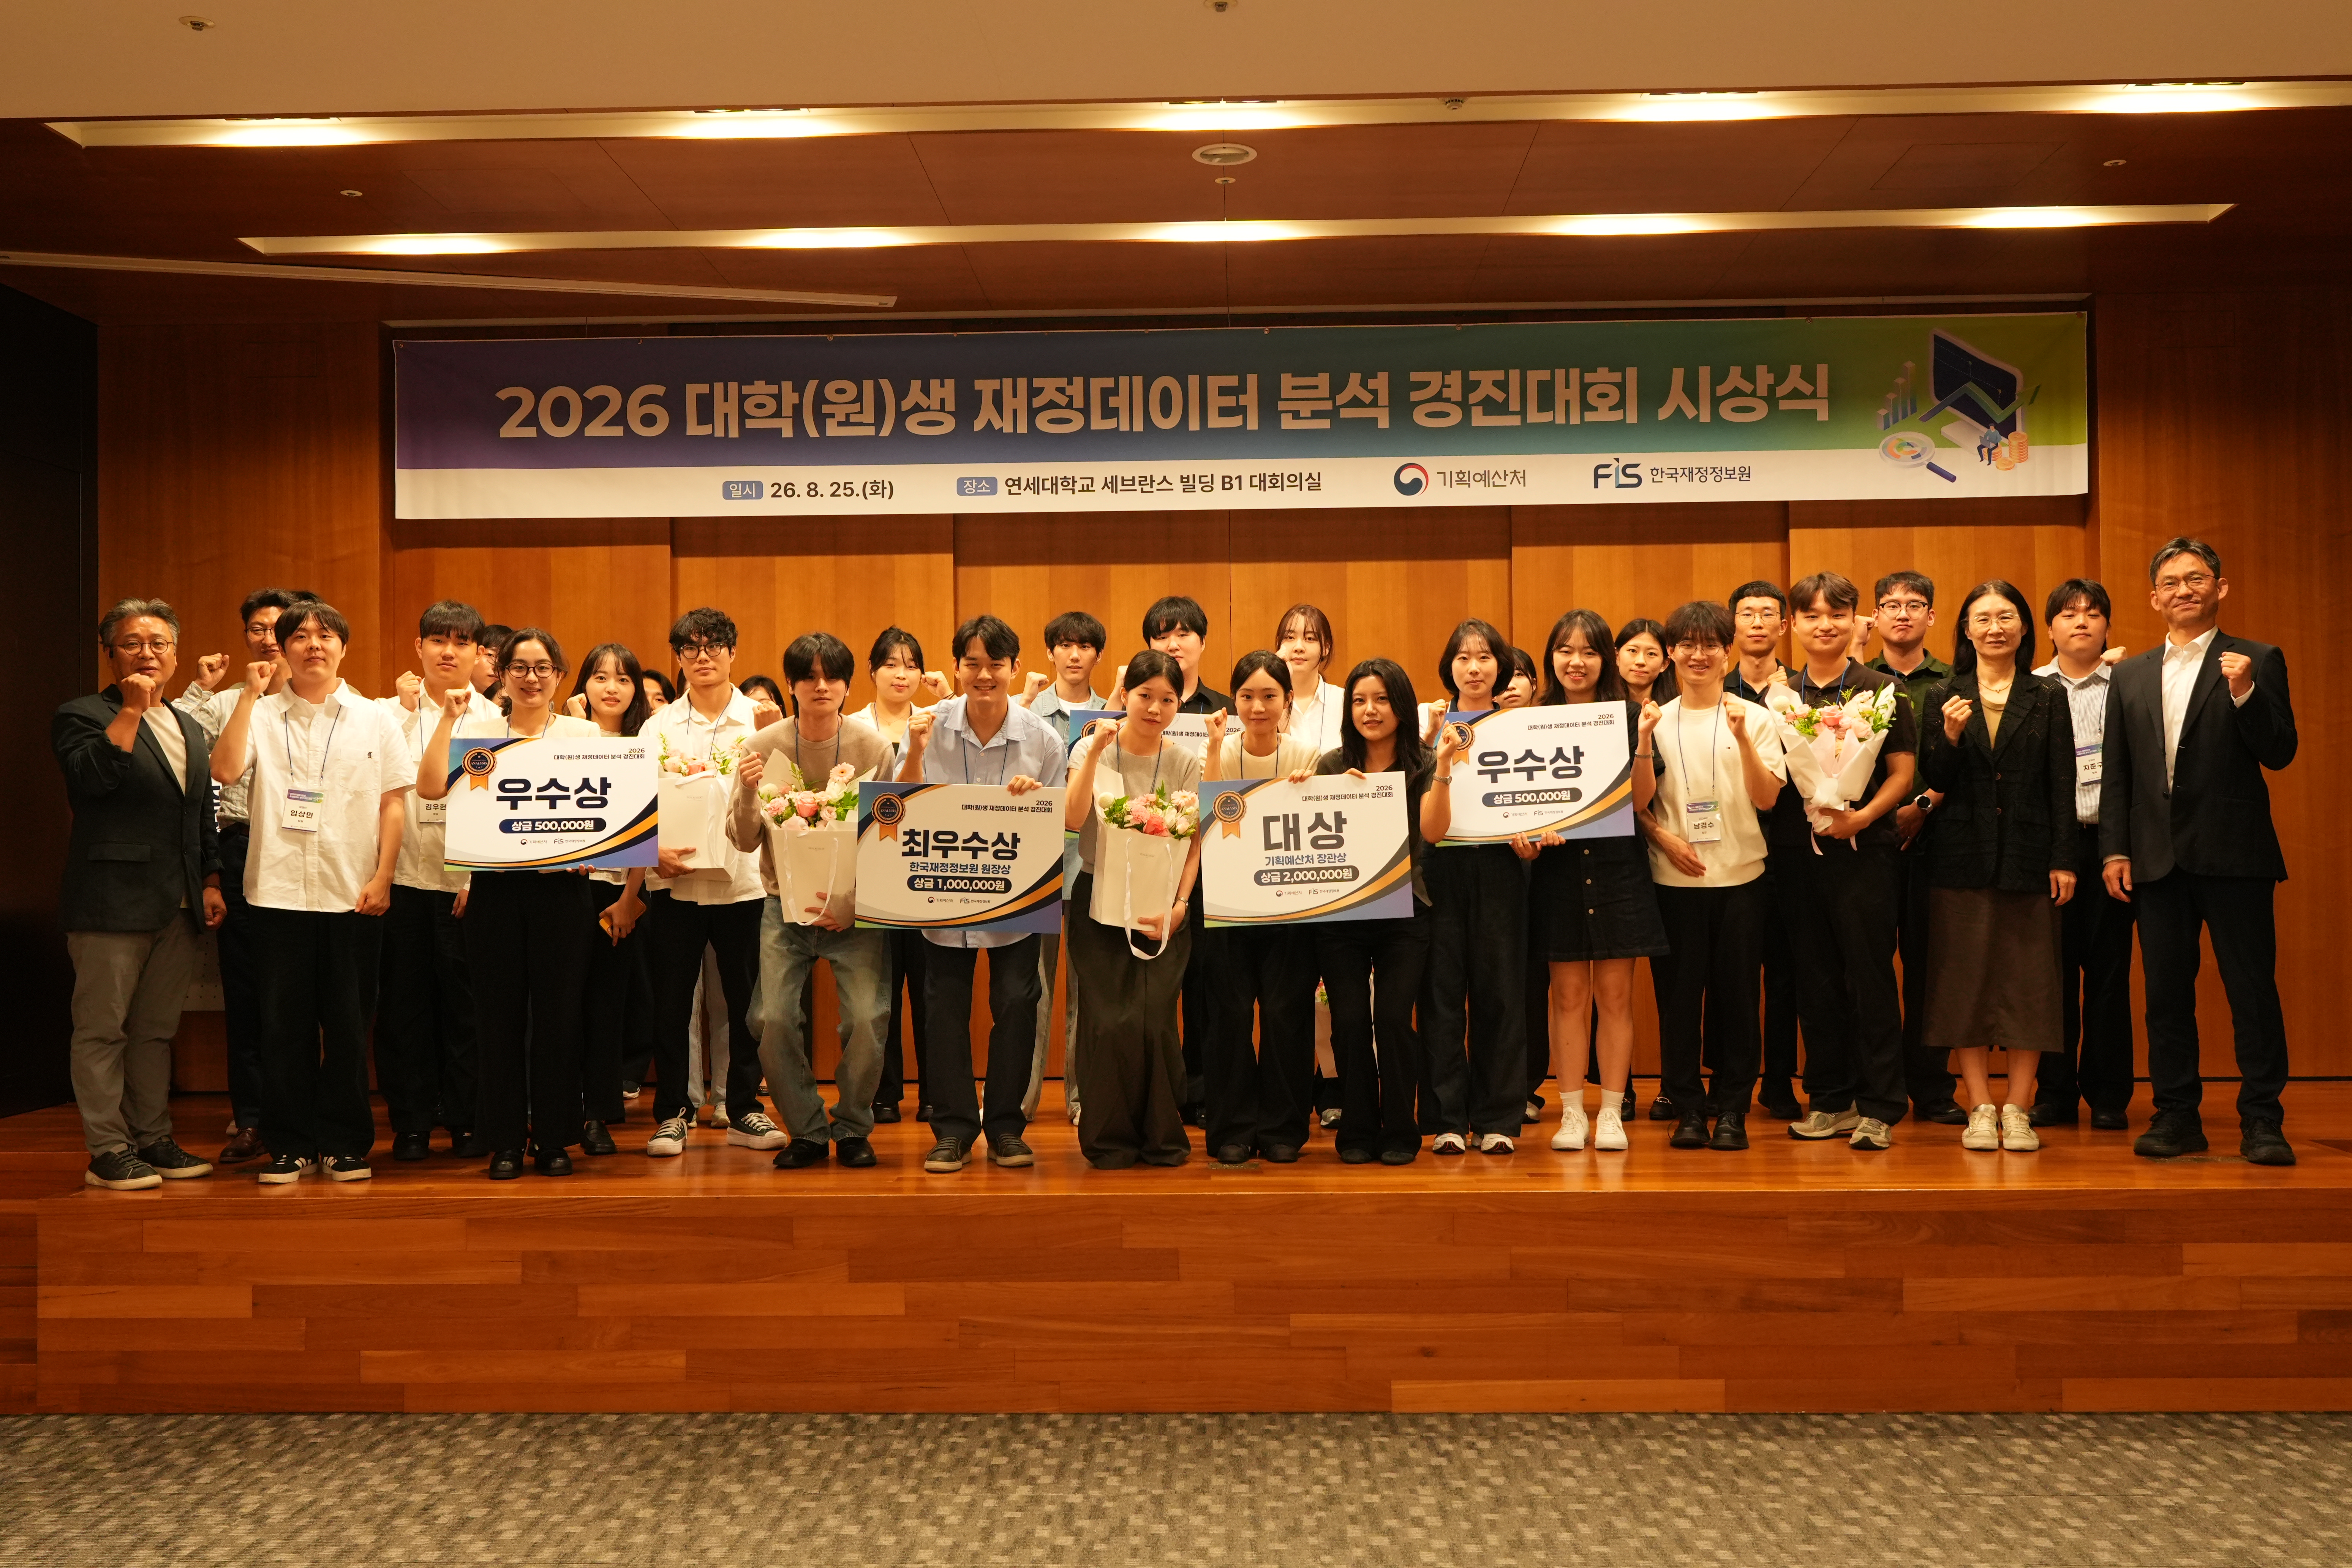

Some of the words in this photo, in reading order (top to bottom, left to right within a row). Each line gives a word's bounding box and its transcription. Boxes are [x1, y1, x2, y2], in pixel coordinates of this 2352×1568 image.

[495, 384, 669, 438] 2026
[686, 379, 955, 438] 대학(원)생
[974, 374, 1258, 433] 재정데이터
[1278, 372, 1389, 429] 분석
[1410, 367, 1638, 427] 경진대회
[1658, 364, 1829, 422] 시상식
[1437, 469, 1525, 488] 기획예산처
[1650, 466, 1750, 482] 한국재정정보원
[730, 483, 755, 497] 일시
[771, 482, 800, 498] 26.
[807, 482, 824, 497] 8.
[830, 480, 893, 499] 25.(화)
[964, 479, 990, 493] 장소
[1005, 476, 1095, 495] 연세대학교
[1101, 475, 1173, 494] 세브란스
[1180, 474, 1214, 493] 빌딩
[1222, 475, 1242, 490] B1
[1250, 472, 1321, 492] 대회의실
[1478, 746, 1584, 783] 우수상
[496, 777, 611, 810] 우수상
[1493, 794, 1513, 805] 상금
[1515, 790, 1571, 803] 500,000원
[291, 810, 313, 819] 임상민
[512, 821, 532, 831] 상금
[534, 820, 593, 831] 500,000원
[1263, 811, 1347, 851] 대상
[902, 829, 1021, 860] 최우수상
[910, 861, 978, 874] 한국재정정보원
[982, 864, 1011, 874] 원장상
[1265, 855, 1314, 866] 기획예산처
[1317, 853, 1346, 863] 장관상
[1261, 872, 1281, 883] 상금
[1283, 868, 1353, 882] 2,000,000원
[914, 878, 934, 888] 상금
[937, 879, 1005, 891] 1,000,000원
